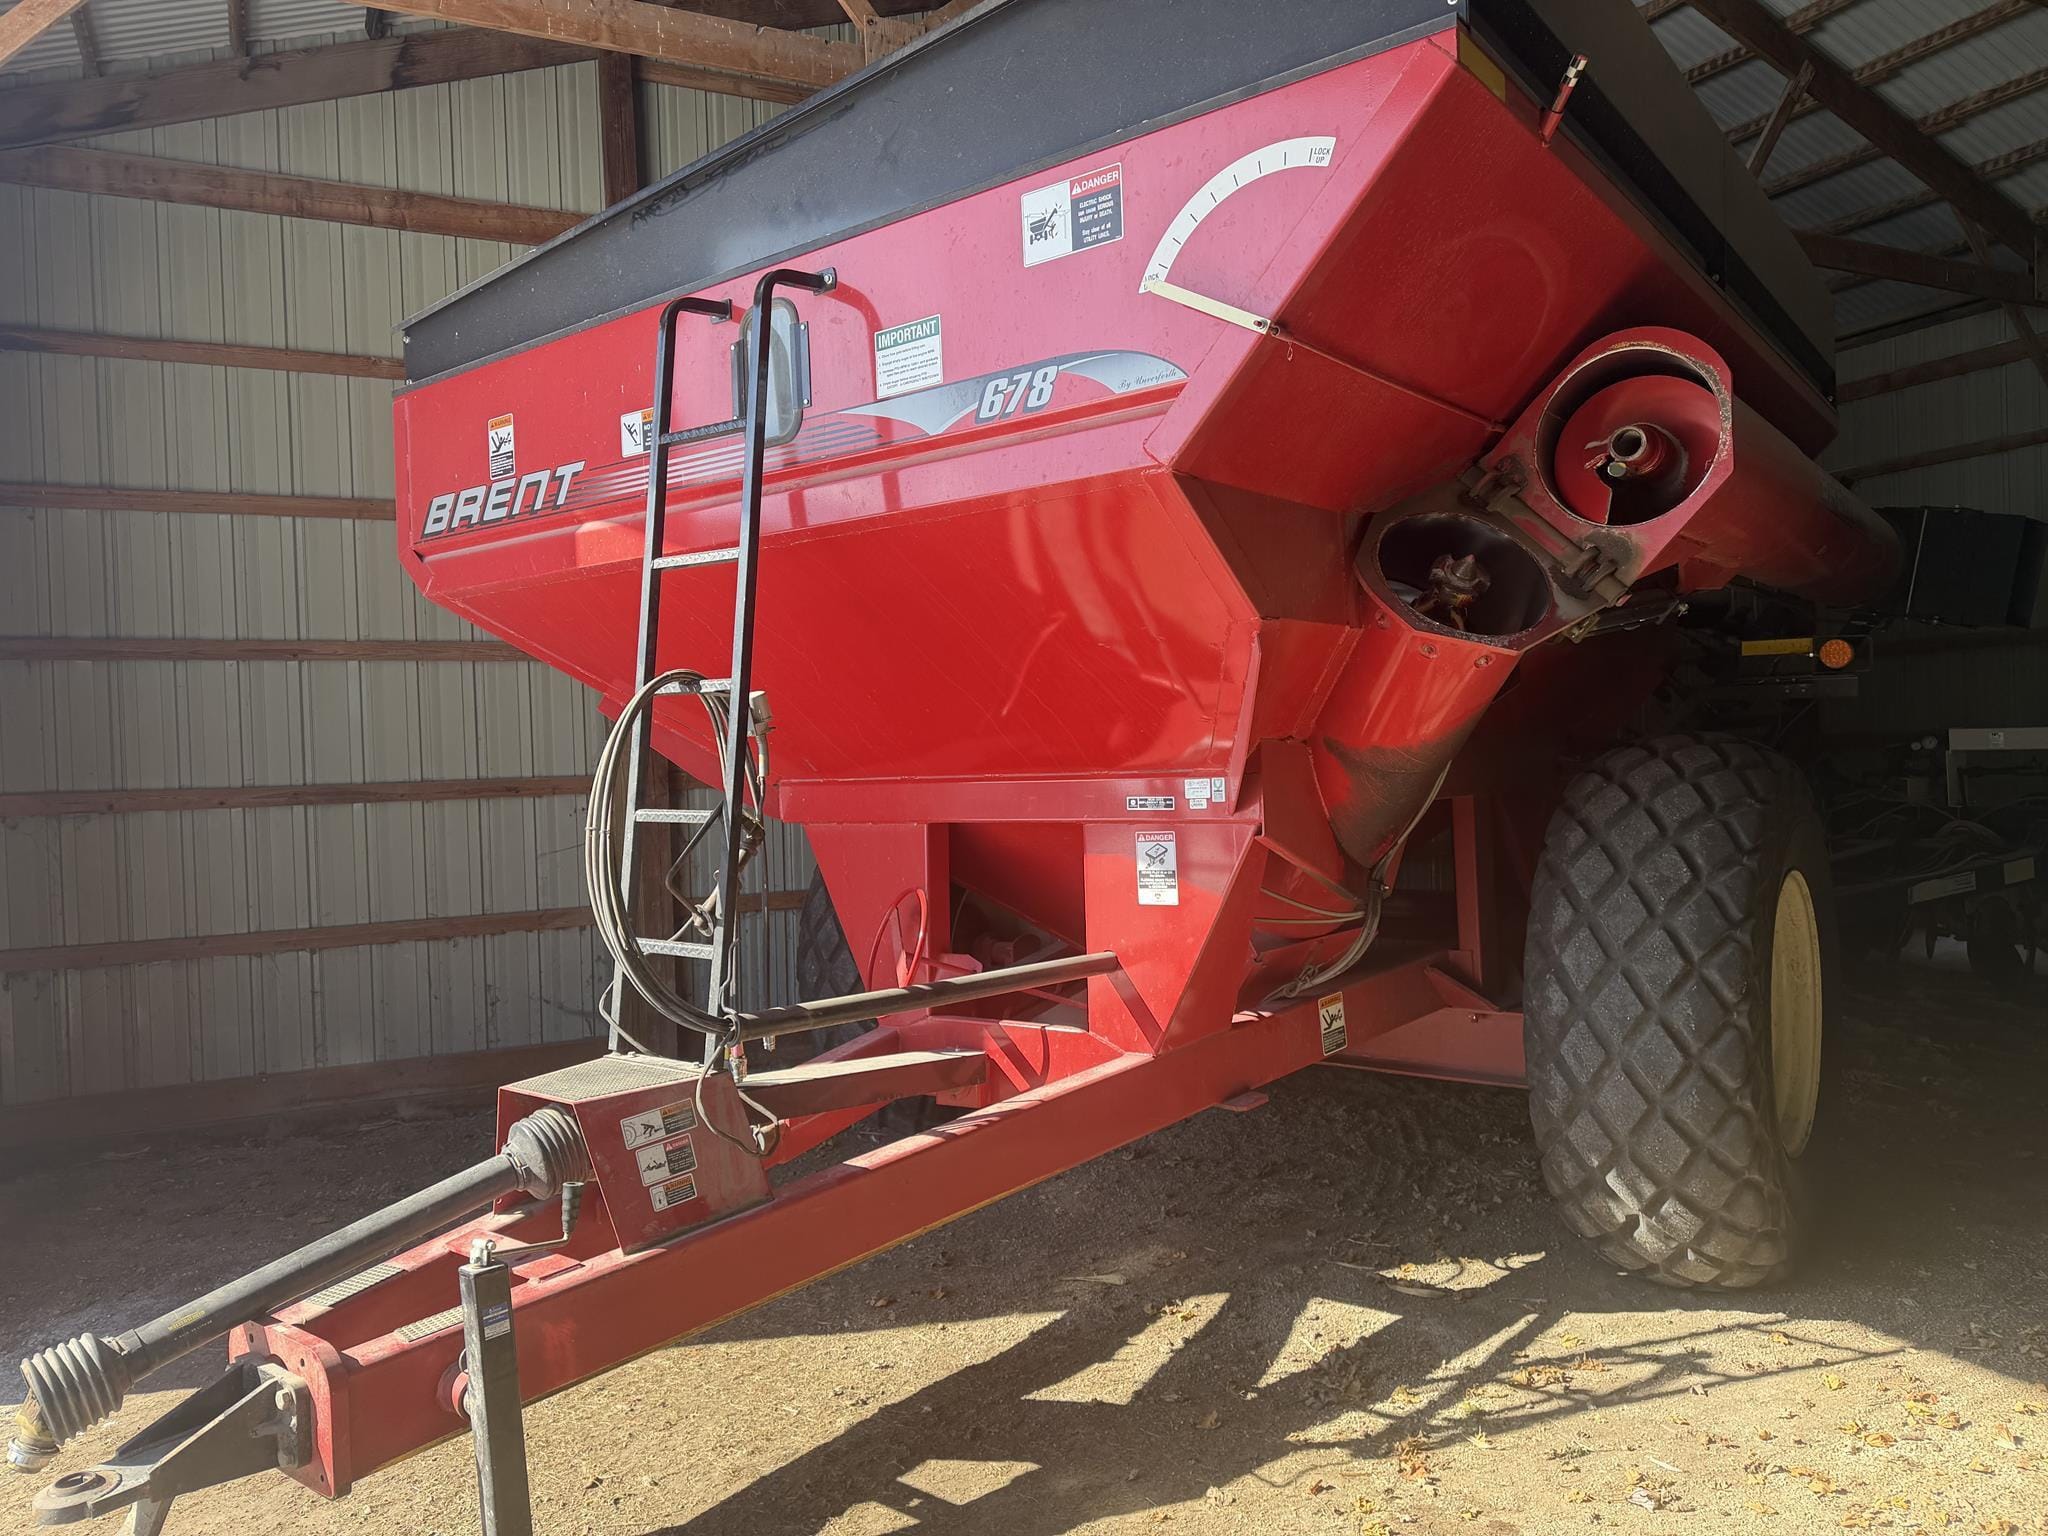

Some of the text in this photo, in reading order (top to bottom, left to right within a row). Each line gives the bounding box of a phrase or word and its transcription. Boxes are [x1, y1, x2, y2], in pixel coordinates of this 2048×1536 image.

[1314, 147, 1331, 155] LOCK
[1081, 170, 1119, 191] DANGER
[1098, 193, 1112, 202] SHOCK
[878, 320, 937, 349] IMPORTANT
[977, 365, 1058, 421] 678
[422, 460, 587, 537] BRENT
[1145, 833, 1173, 841] DANGER
